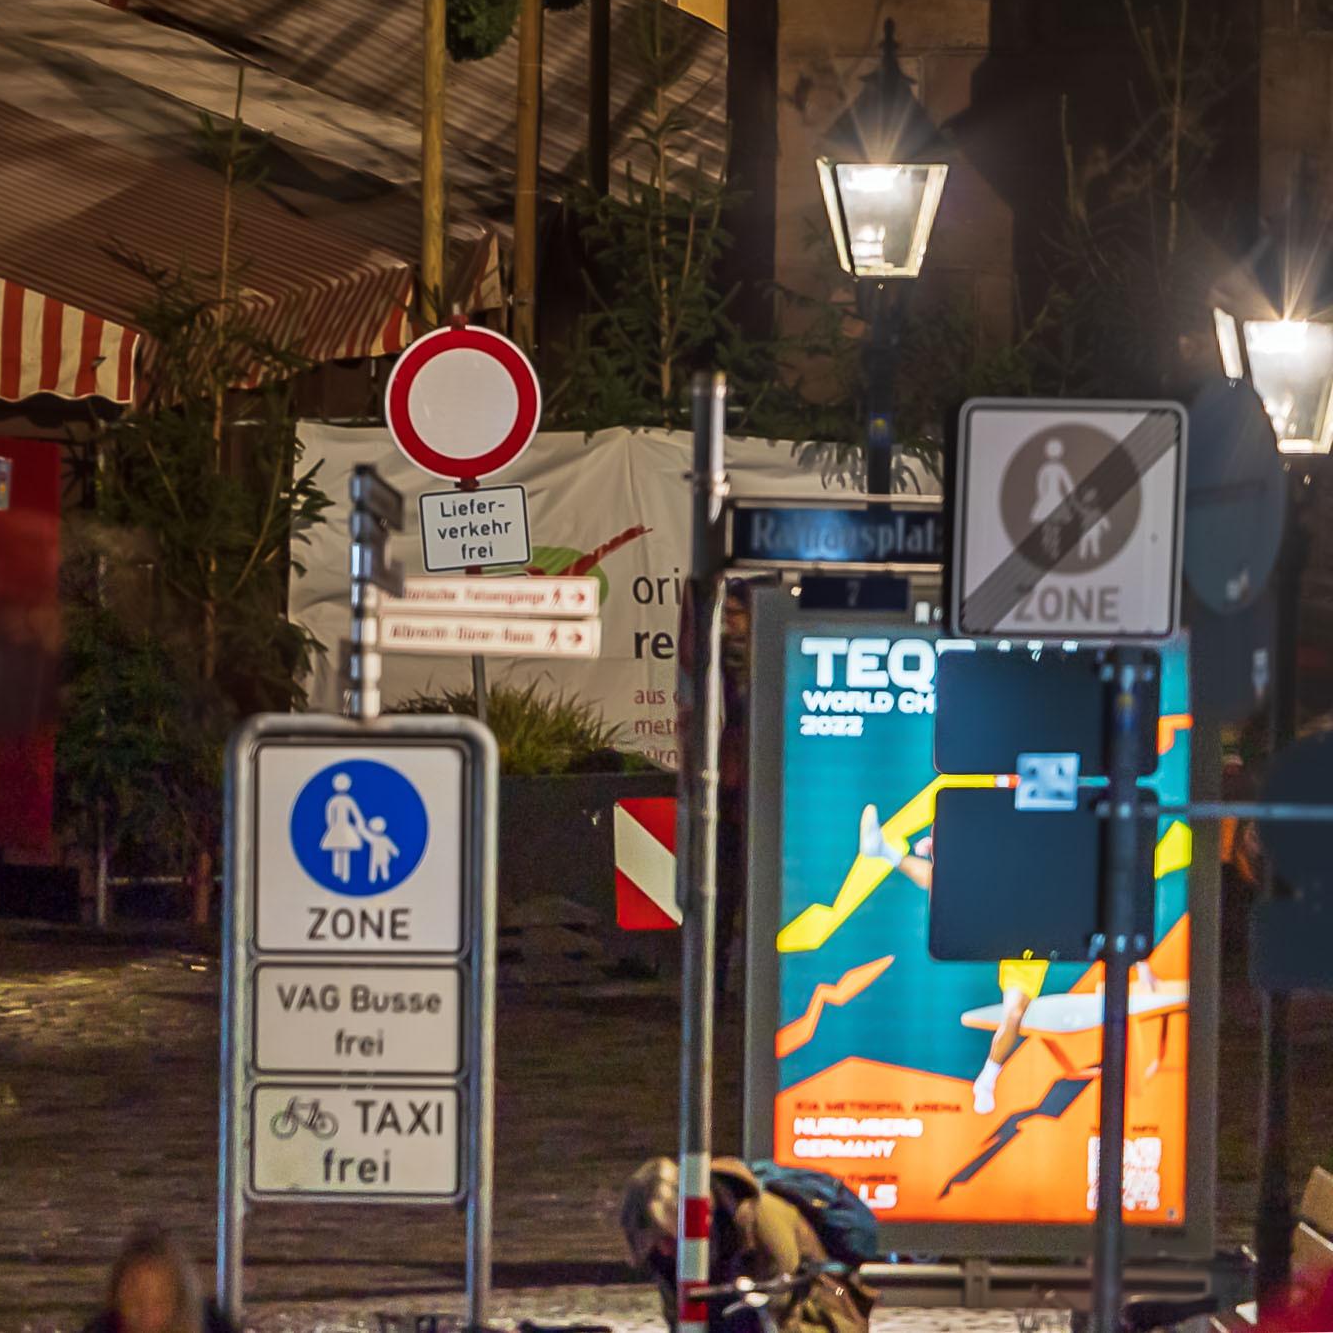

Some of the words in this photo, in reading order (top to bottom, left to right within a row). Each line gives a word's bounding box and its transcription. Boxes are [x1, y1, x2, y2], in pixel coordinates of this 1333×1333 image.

[439, 499, 505, 518] Liefer-
[437, 519, 512, 540] verkehr
[461, 541, 493, 559] frei
[1013, 584, 1121, 623] ZONE
[634, 689, 666, 706] aus
[801, 689, 895, 714] WORLD
[799, 714, 864, 737] 2022
[307, 907, 412, 941] ZONE
[276, 984, 341, 1013] VAG
[349, 984, 442, 1014] Busse
[334, 1028, 385, 1057] frei
[353, 1099, 444, 1136] TAXI
[793, 1138, 897, 1159] GERMANY
[322, 1147, 392, 1184] frei
